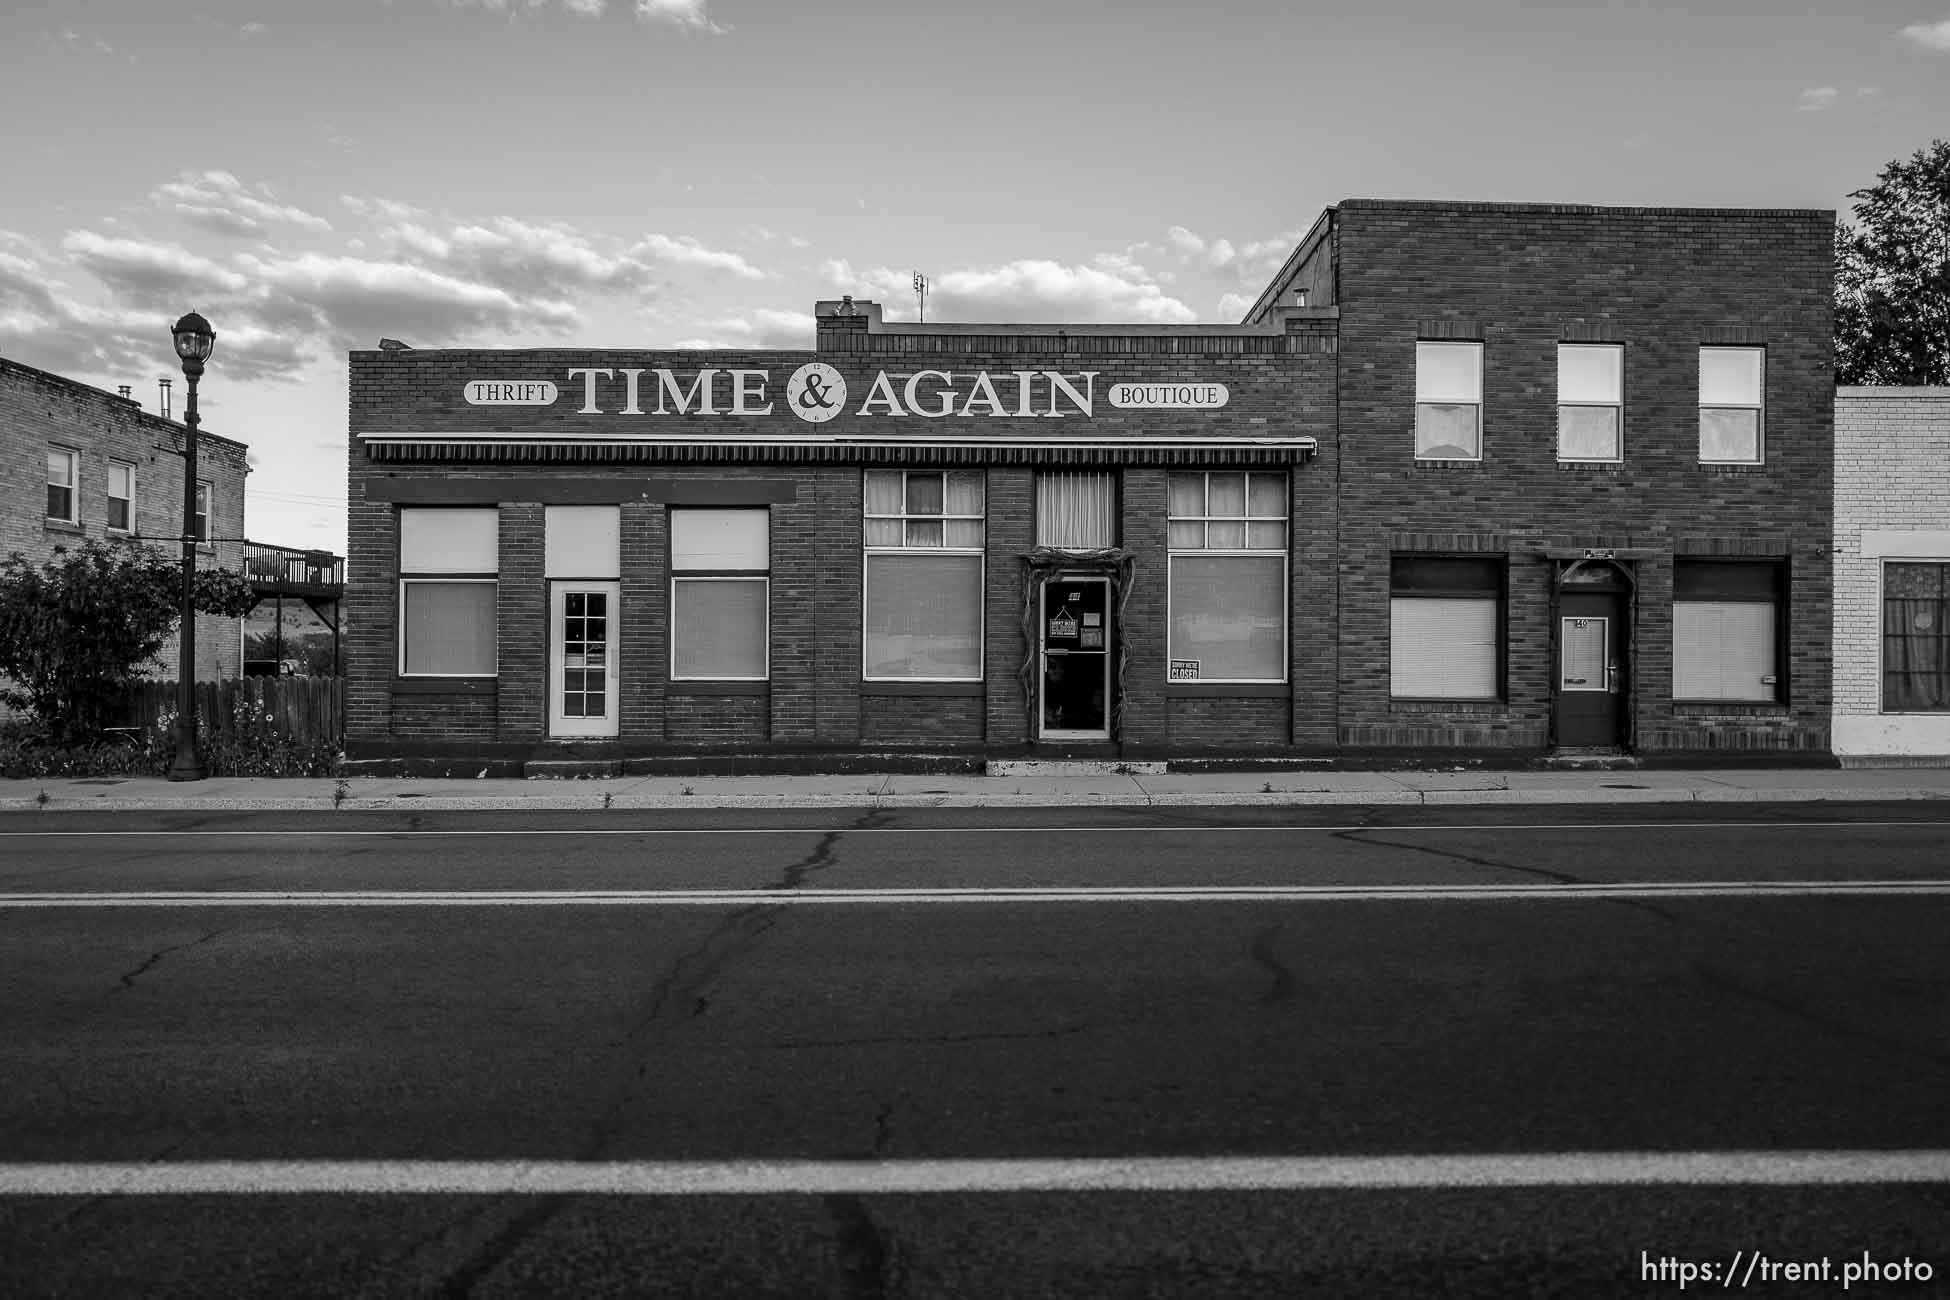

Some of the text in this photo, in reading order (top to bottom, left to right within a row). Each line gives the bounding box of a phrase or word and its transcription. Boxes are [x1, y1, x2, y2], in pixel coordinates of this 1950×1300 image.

[473, 384, 549, 401] THRIFT
[568, 368, 1100, 418] TIME & AGAIN
[1119, 387, 1218, 405] BOUTIQUE
[1171, 668, 1198, 679] CLOSED
